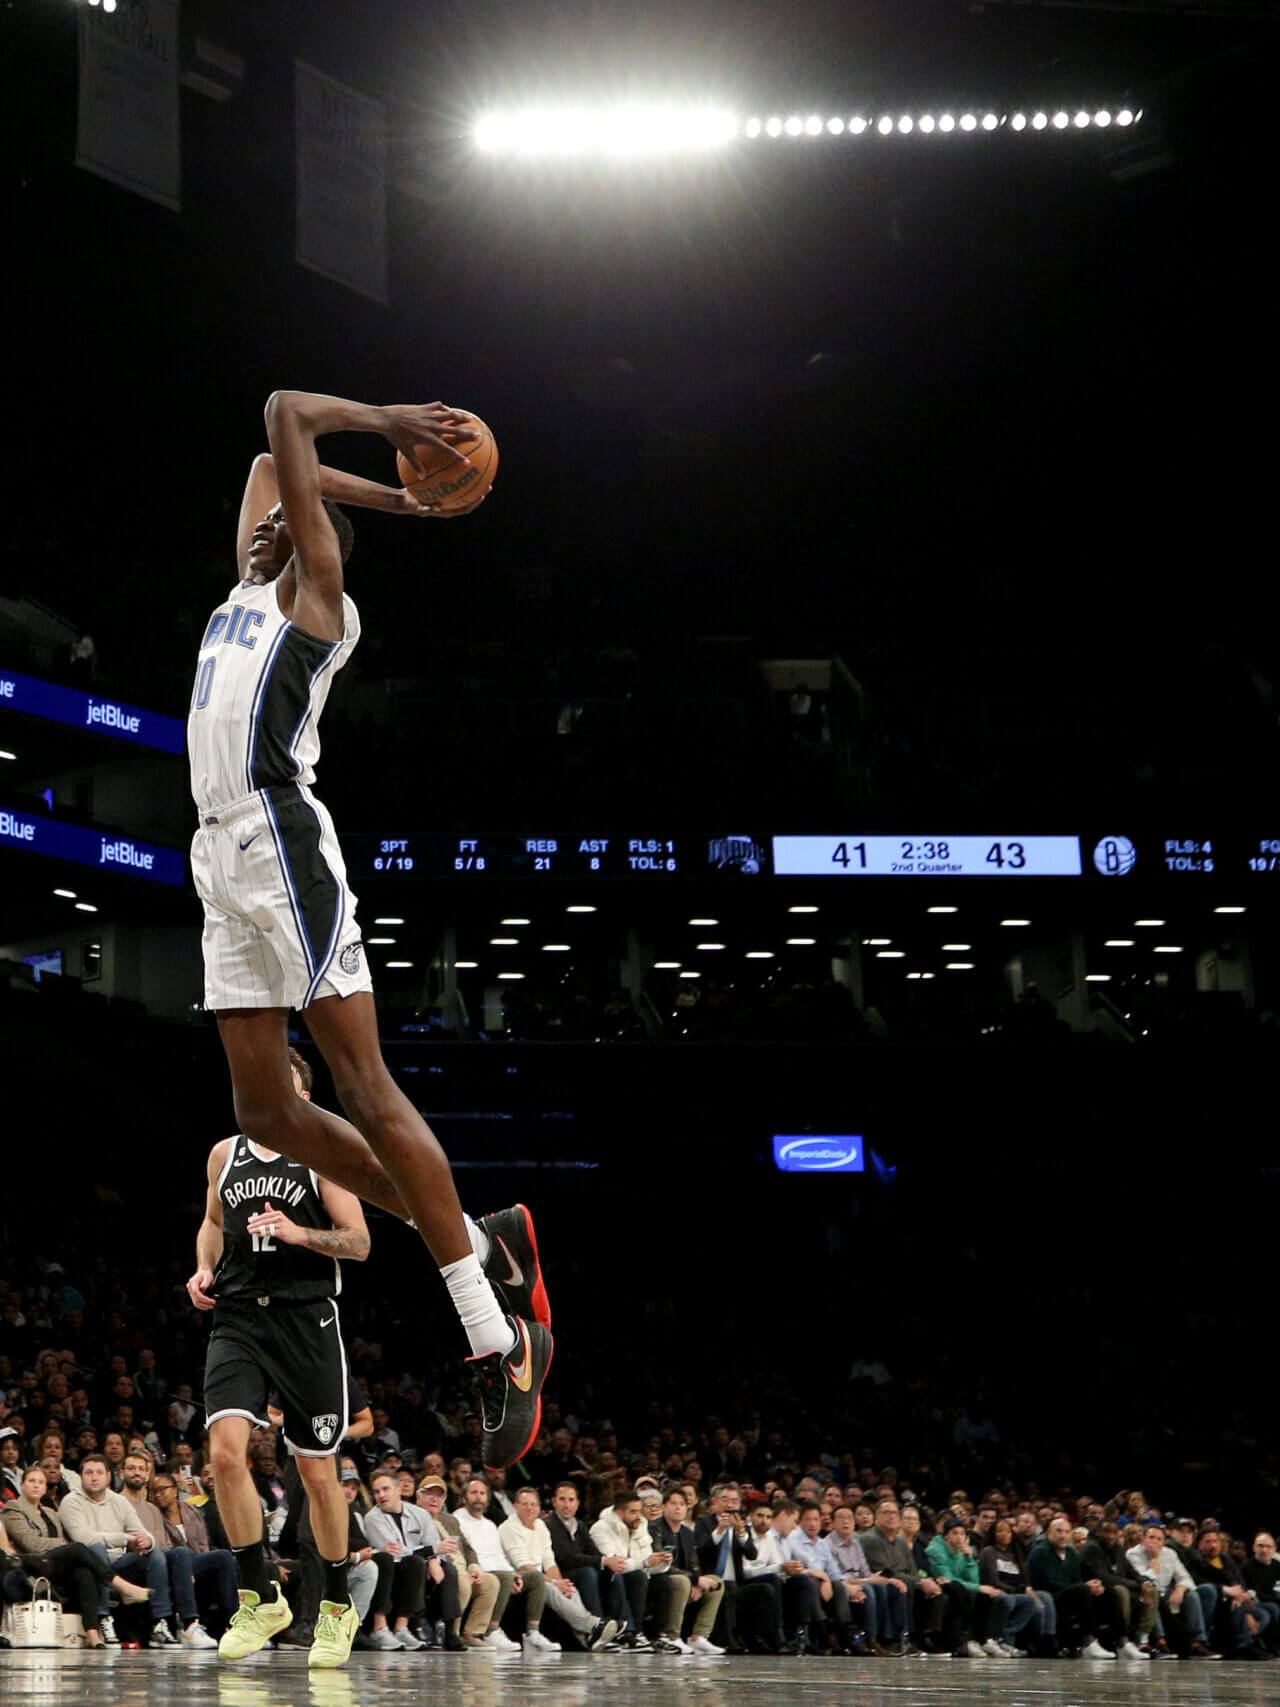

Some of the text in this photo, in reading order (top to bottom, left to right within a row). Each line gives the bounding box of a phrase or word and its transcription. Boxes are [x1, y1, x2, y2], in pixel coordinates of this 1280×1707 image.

[87, 700, 140, 733] jetBlue
[380, 840, 408, 852] 3PT
[460, 840, 478, 852] FT
[526, 840, 557, 852] REB
[580, 840, 608, 852] AST
[901, 842, 950, 860] 2:38
[101, 838, 153, 870] jetBlue
[832, 842, 867, 868] 41
[986, 842, 1026, 868] 43
[535, 858, 550, 870] 21
[590, 858, 600, 870] 8
[891, 863, 963, 872] 2nd Quarter
[224, 1176, 307, 1209] BROOKLYN
[314, 1415, 338, 1429] NETS
